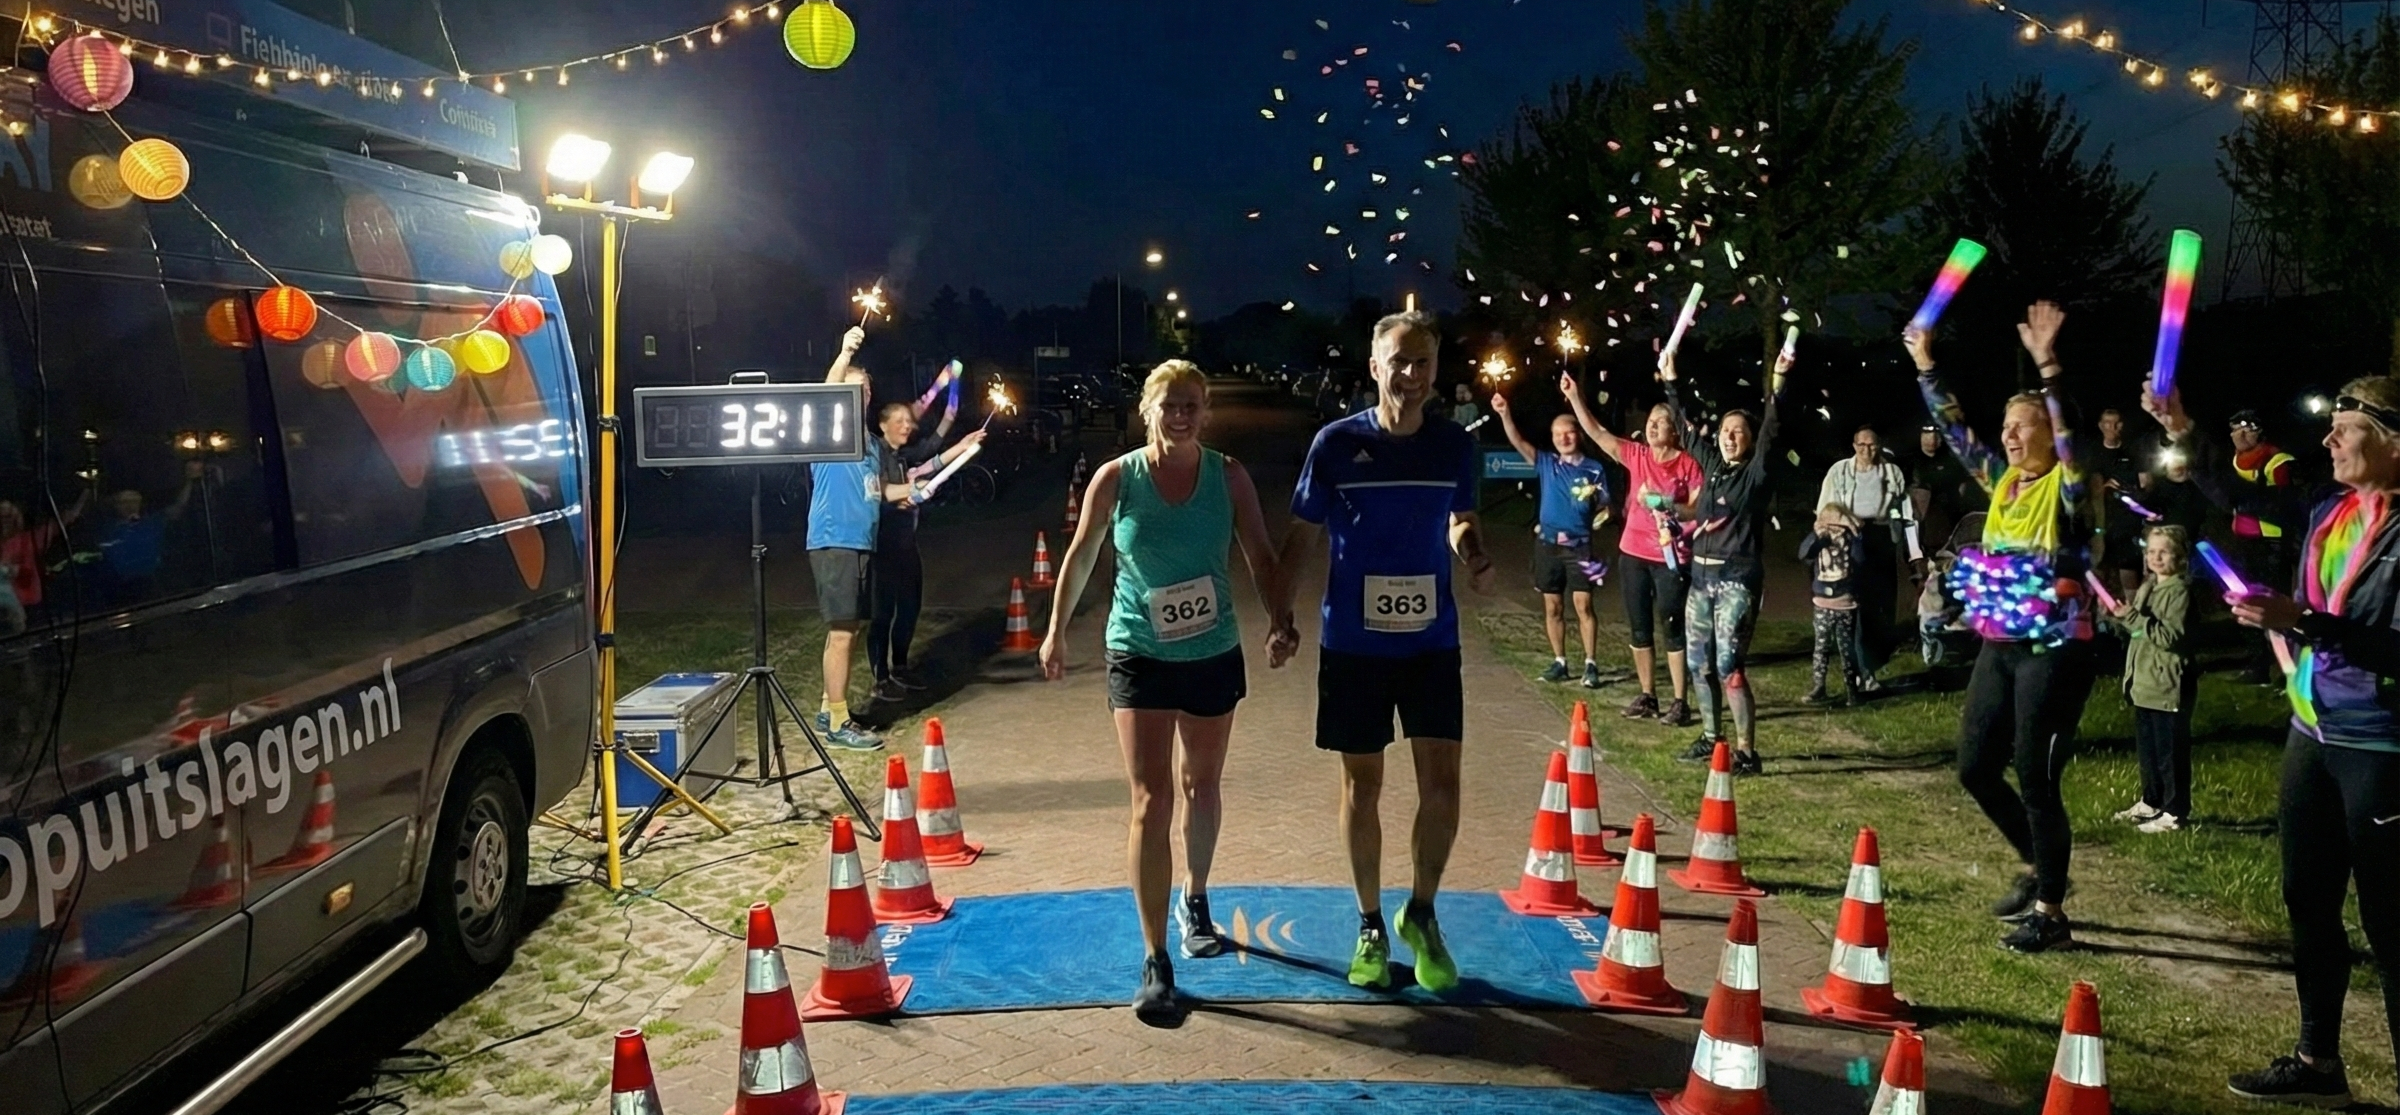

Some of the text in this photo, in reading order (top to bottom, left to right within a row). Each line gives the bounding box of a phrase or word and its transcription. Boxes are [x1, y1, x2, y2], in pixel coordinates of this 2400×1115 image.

[720, 402, 844, 448] 32:11
[1162, 596, 1211, 624] 362
[1376, 593, 1427, 615] 363
